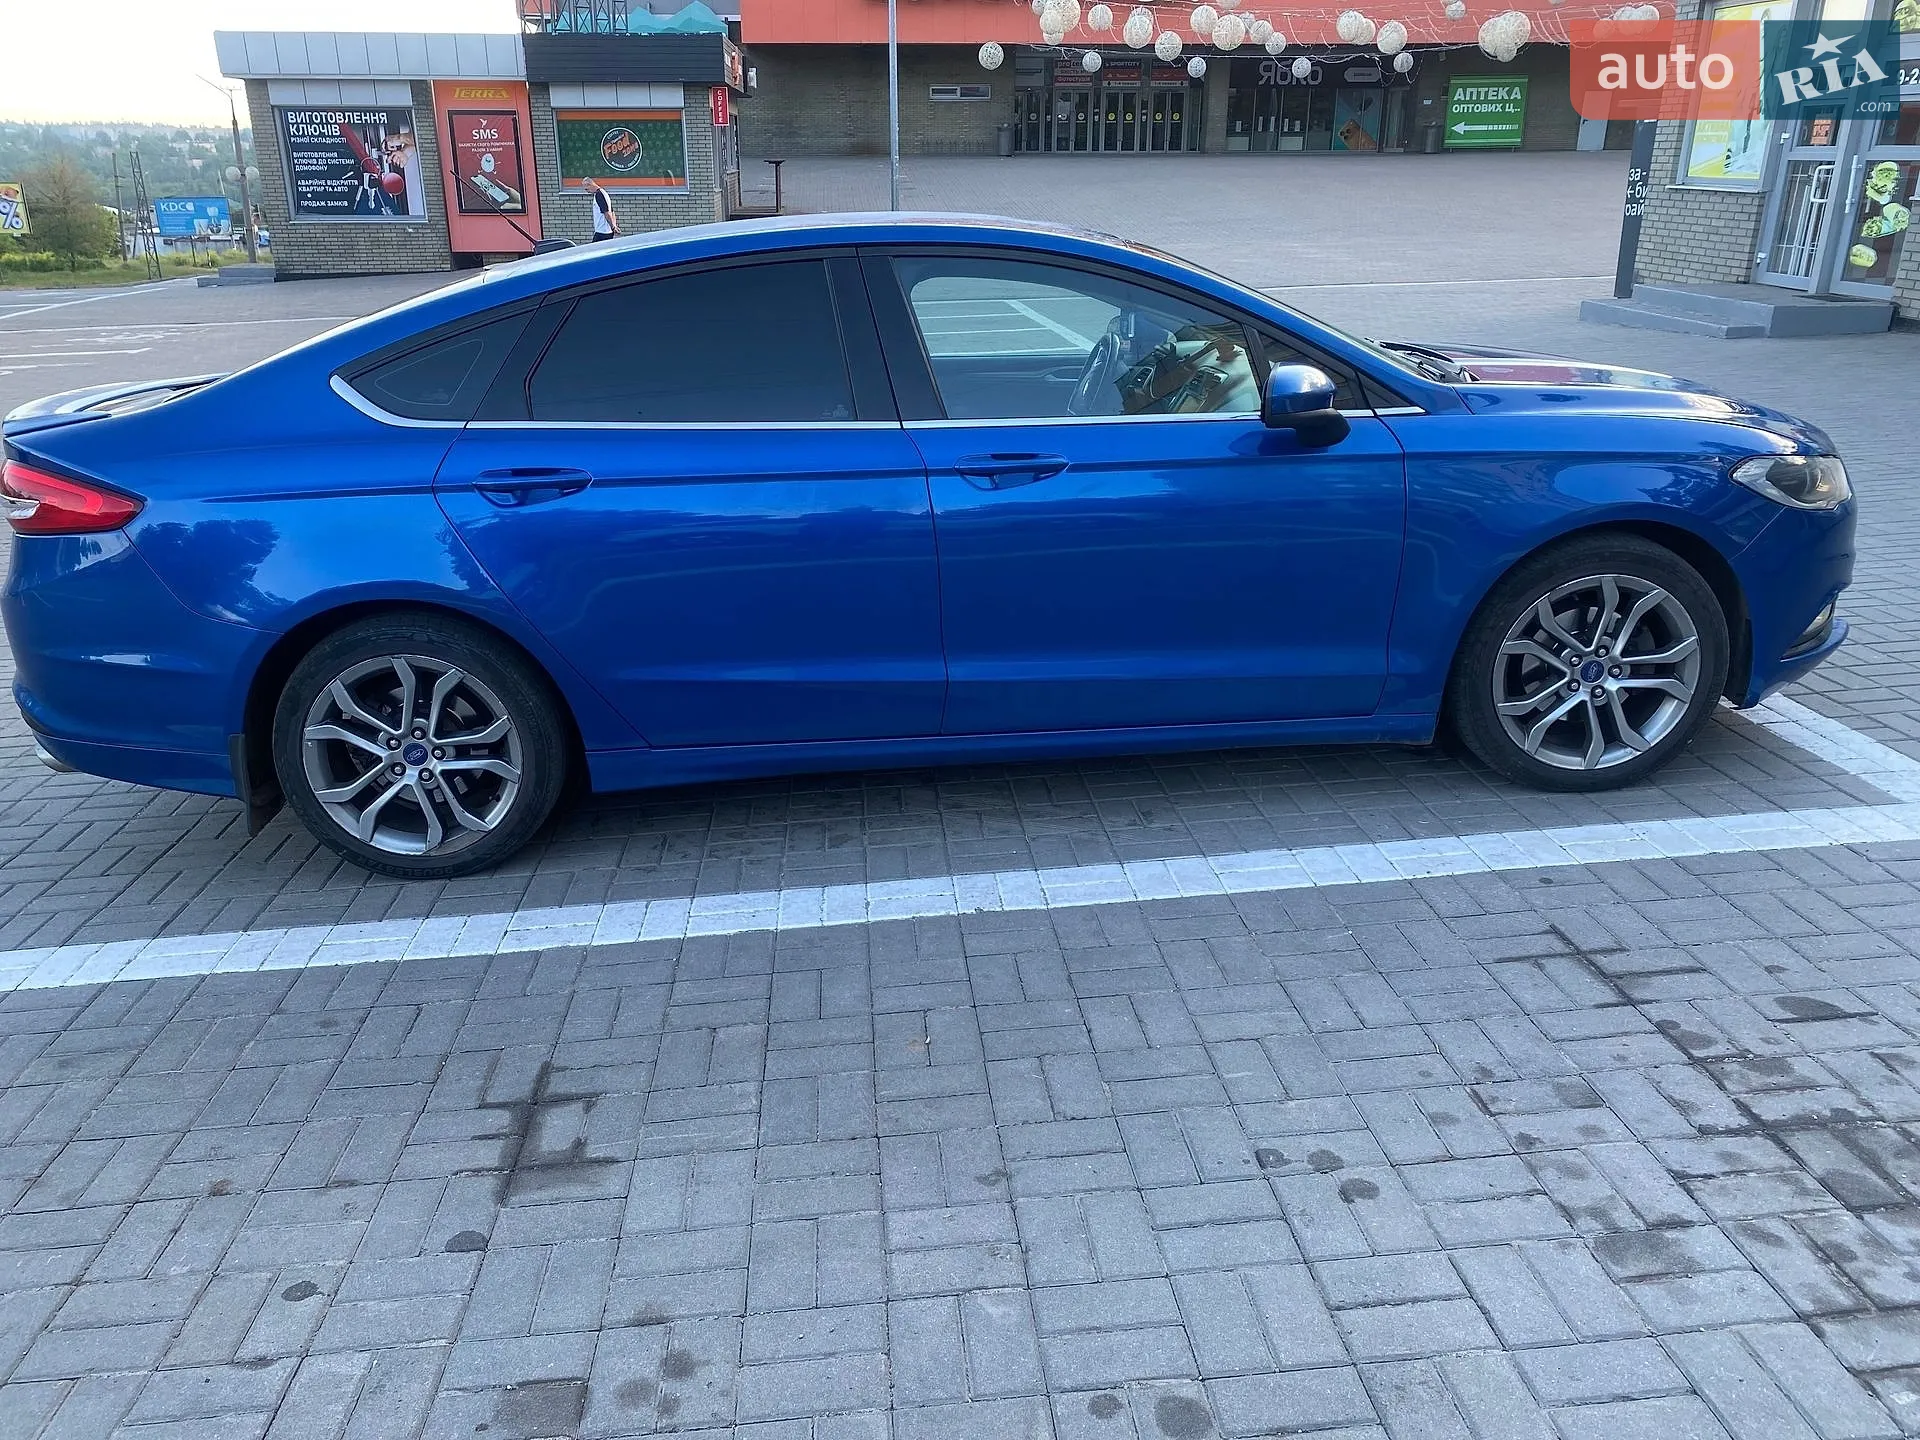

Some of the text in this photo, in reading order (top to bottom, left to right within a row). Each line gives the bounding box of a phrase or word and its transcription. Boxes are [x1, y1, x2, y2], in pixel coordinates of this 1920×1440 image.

[1454, 86, 1522, 101] АПТЕКА
[1452, 103, 1503, 113] ОПТОВИХ
[287, 111, 388, 124] ВИГОТОВЛЕННЯ
[289, 123, 341, 136] КЛЮЧІВ
[472, 128, 499, 139] SMS
